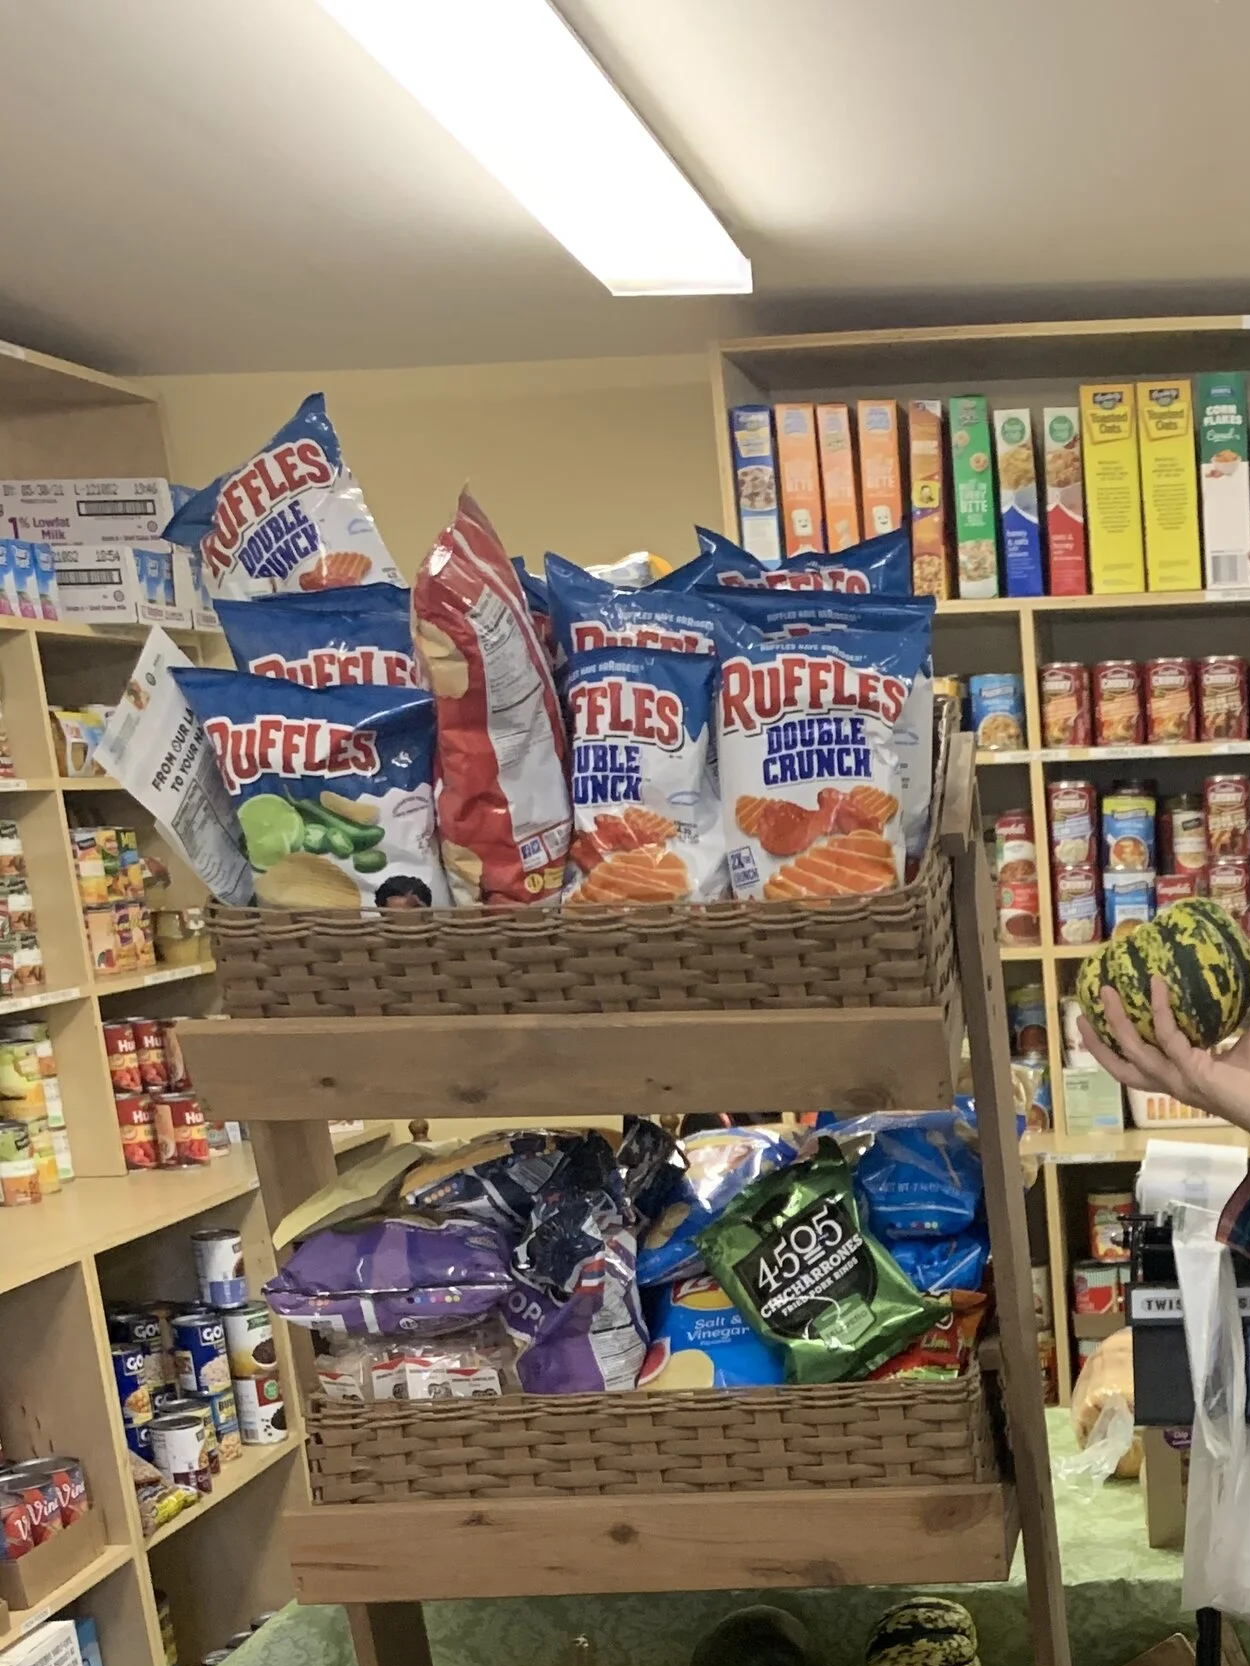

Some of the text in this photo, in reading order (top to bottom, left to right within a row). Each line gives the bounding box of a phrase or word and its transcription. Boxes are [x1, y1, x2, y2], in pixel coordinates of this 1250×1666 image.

[1090, 413, 1127, 424] Toasted
[1147, 409, 1184, 420] Toasted
[1204, 415, 1242, 426] FLAKES
[1206, 405, 1237, 415] CORN
[1100, 424, 1121, 434] Oats
[1155, 420, 1178, 431] Oats
[33, 517, 70, 528] Lowfat
[203, 443, 331, 578] RUFFLES
[41, 529, 66, 540] Milk
[238, 500, 309, 577] DOUBLE
[254, 523, 320, 581] RUNCH
[722, 658, 905, 731] RUFFLES
[767, 717, 867, 756] DOUBLE
[151, 751, 178, 792] FROM
[173, 721, 193, 753] OUR
[171, 745, 200, 793] TO YOUR
[207, 719, 380, 792] RUFFLES
[575, 745, 641, 775] UBLE
[763, 747, 872, 786] CRUNCH
[573, 775, 643, 804] UNCH
[731, 853, 745, 870] 2X
[757, 1205, 843, 1293] 4505
[760, 1233, 864, 1319] CHICHARRONES
[781, 1257, 860, 1317] FRIED PORK RINDS
[1146, 1299, 1182, 1311] TWIS
[686, 1325, 750, 1343] Vinegar
[695, 1314, 742, 1330] Salt &
